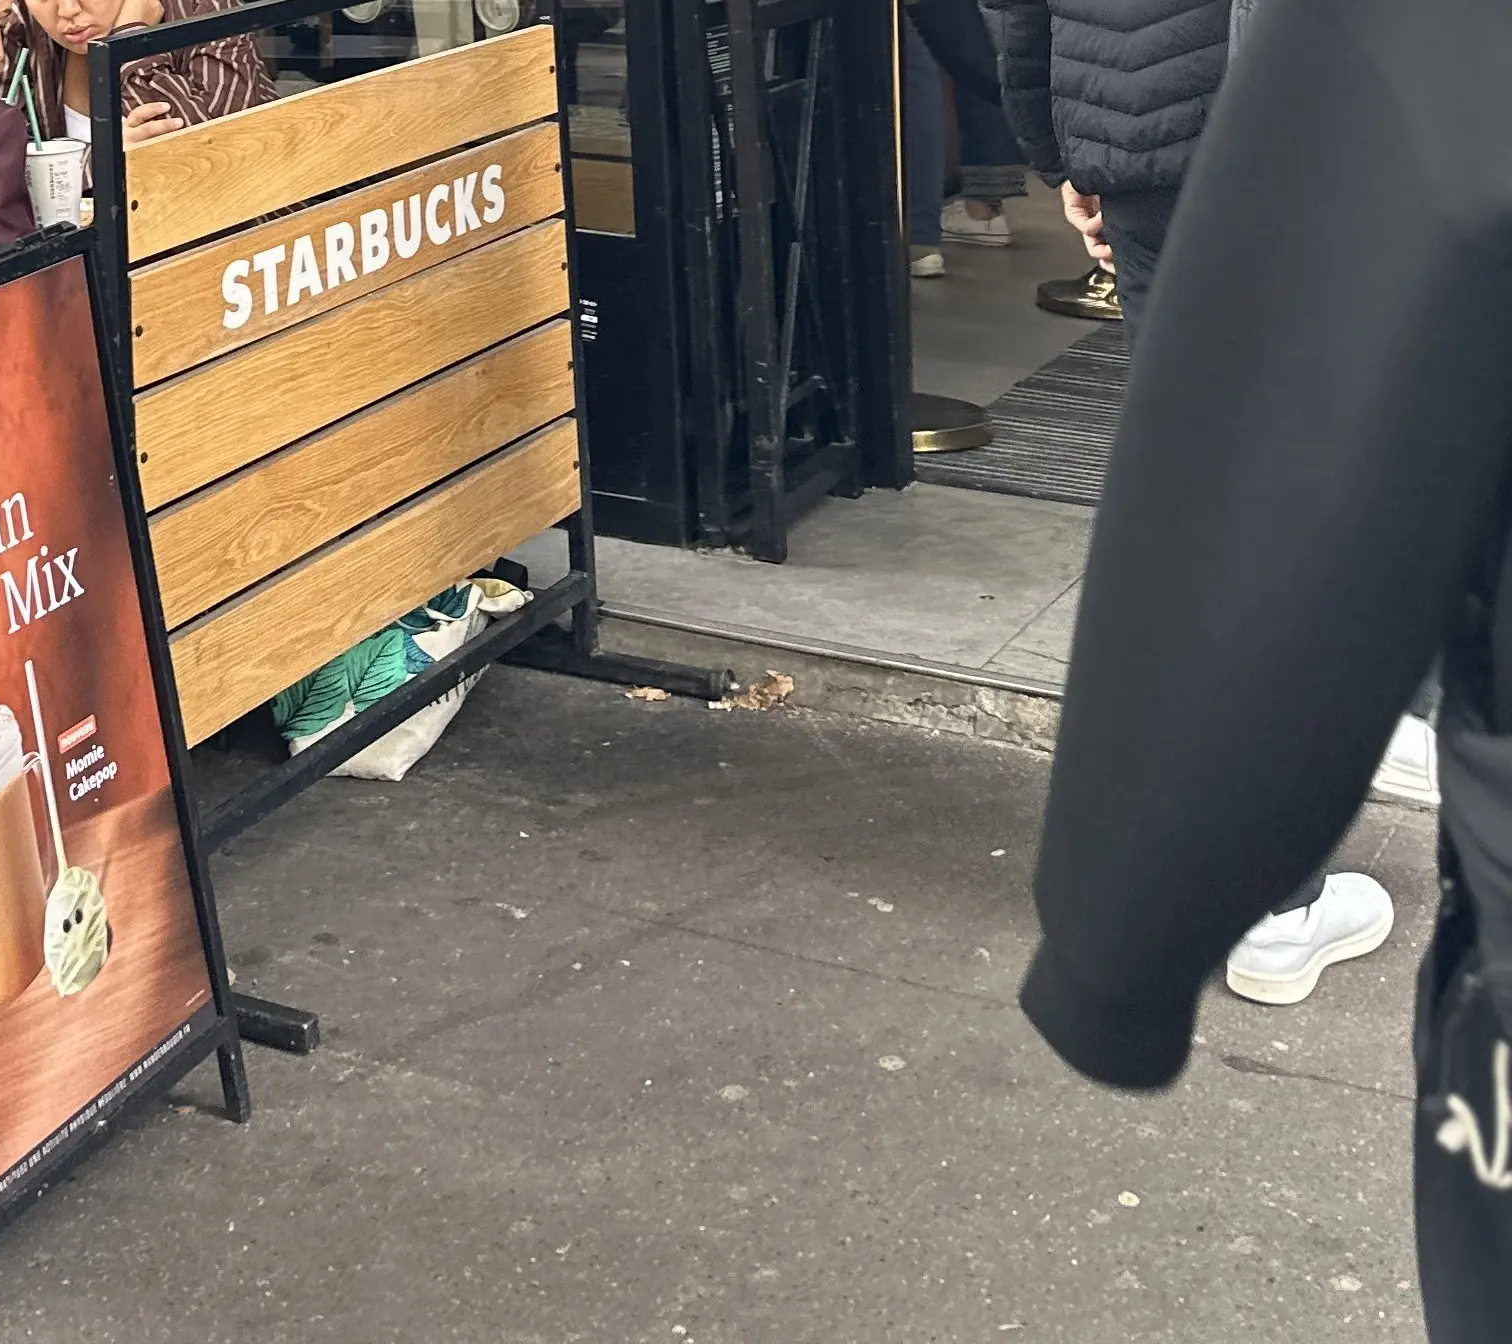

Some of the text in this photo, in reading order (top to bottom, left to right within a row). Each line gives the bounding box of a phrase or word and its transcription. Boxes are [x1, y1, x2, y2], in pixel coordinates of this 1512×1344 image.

[221, 164, 506, 330] STARBUCKS
[0, 545, 86, 635] Mix
[65, 744, 105, 780] Momie
[69, 761, 118, 801] Cakepop
